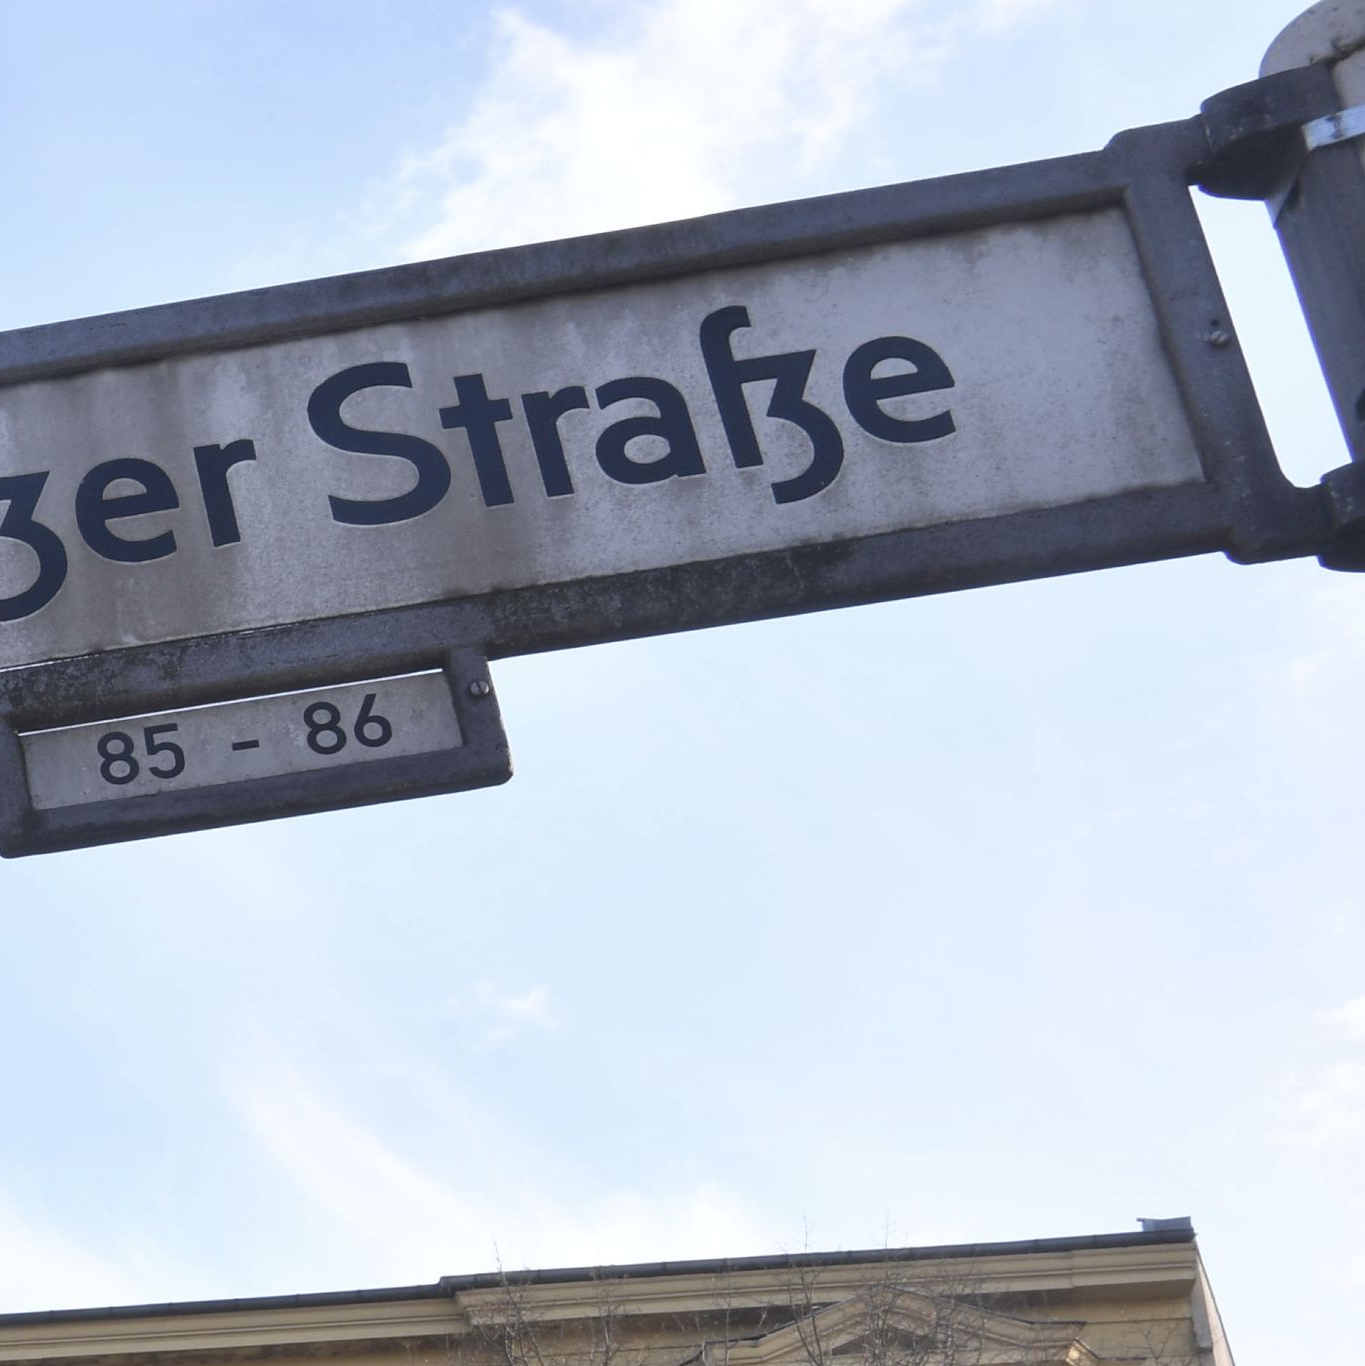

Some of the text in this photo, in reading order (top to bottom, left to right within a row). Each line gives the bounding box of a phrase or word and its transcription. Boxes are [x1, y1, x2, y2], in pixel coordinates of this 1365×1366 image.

[306, 304, 957, 526] Straße
[96, 722, 186, 786] 85
[302, 692, 394, 756] 86
